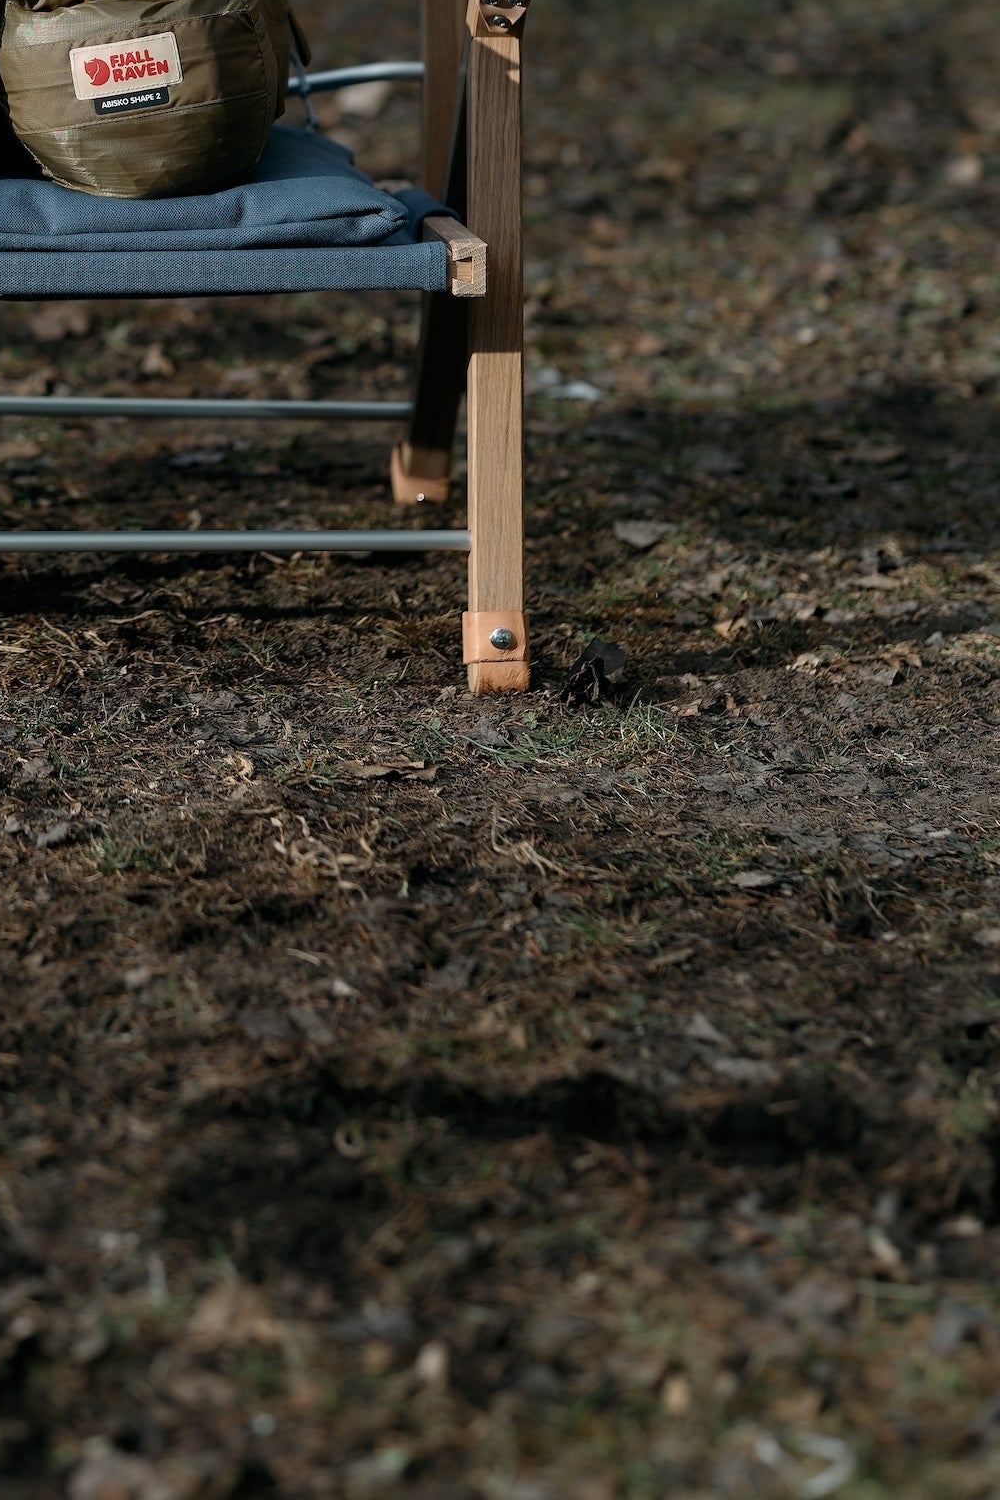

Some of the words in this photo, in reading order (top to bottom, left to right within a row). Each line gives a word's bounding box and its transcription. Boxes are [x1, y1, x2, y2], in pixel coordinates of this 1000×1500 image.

[109, 49, 154, 68] FJÄLL
[112, 60, 169, 82] RÄVEN
[101, 98, 129, 109] ABISKO
[130, 93, 155, 104] SHAPE
[155, 92, 161, 100] 2
